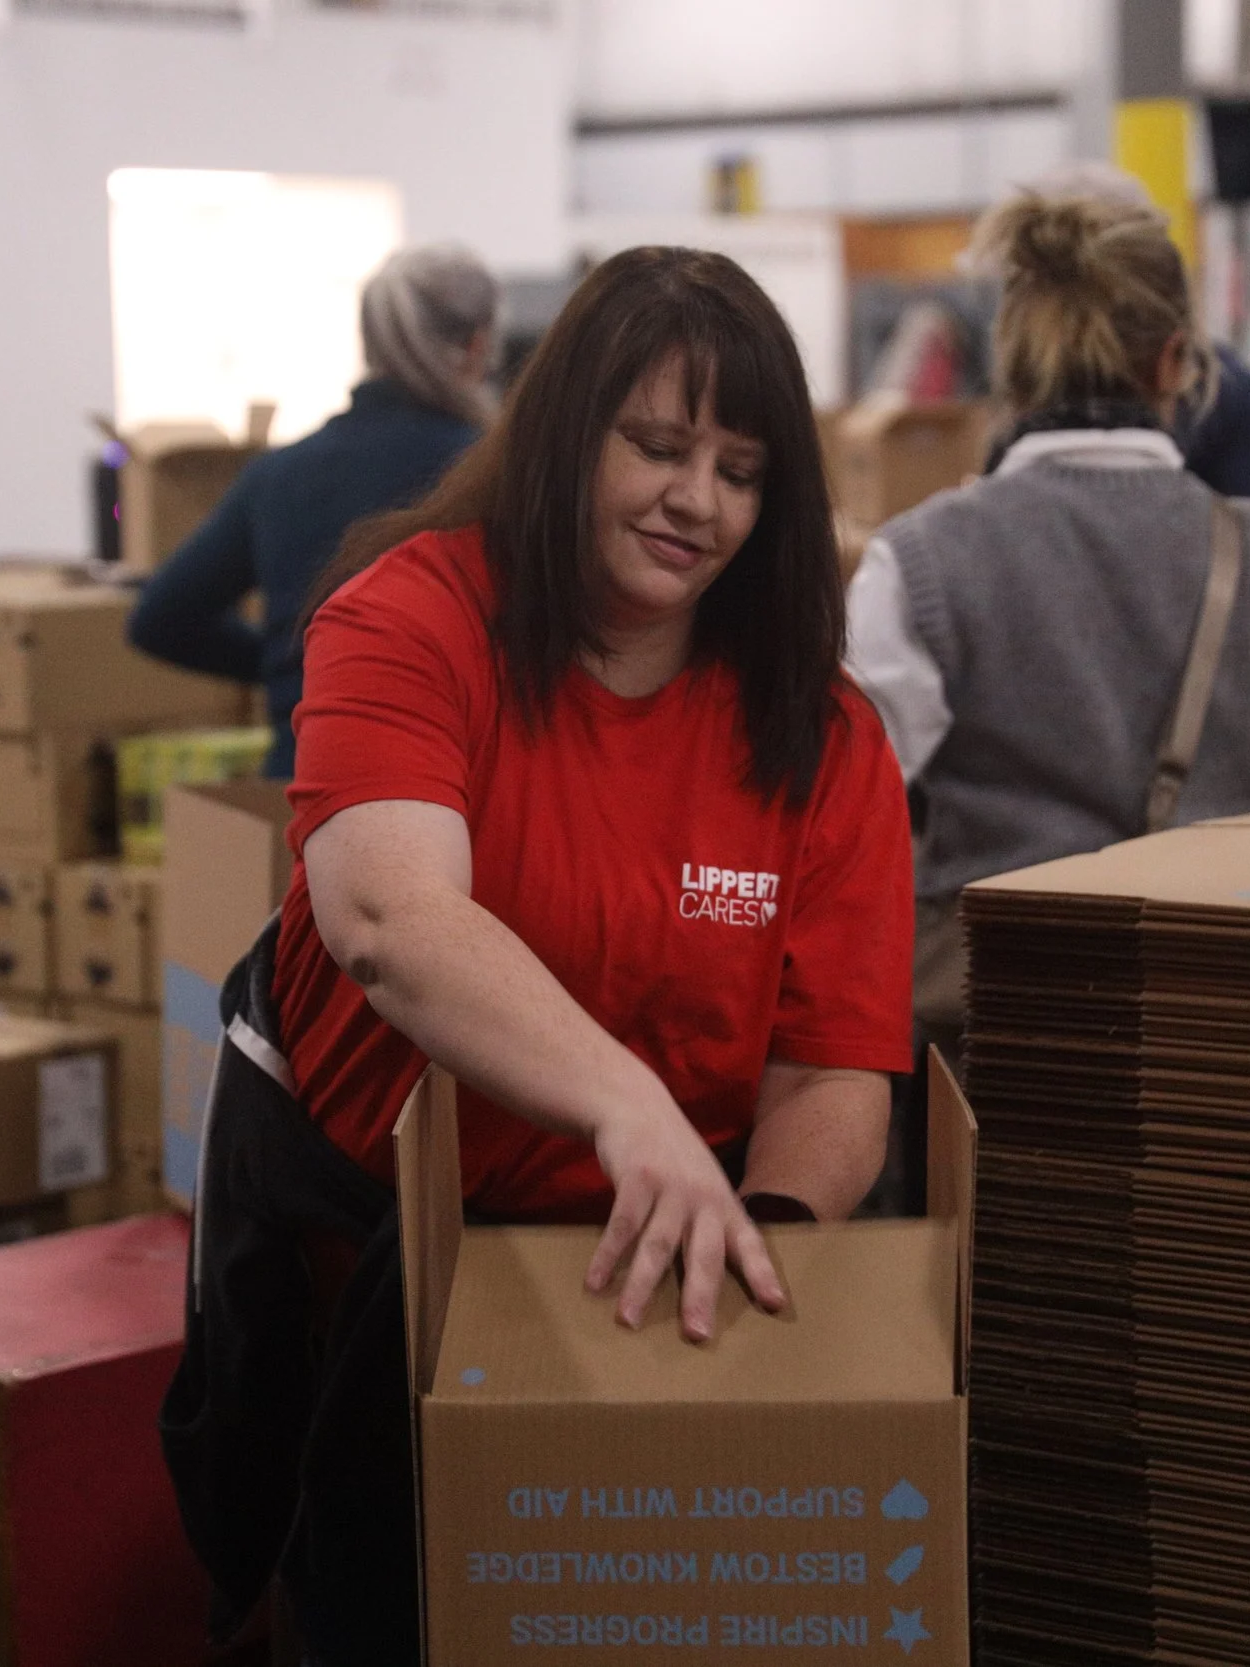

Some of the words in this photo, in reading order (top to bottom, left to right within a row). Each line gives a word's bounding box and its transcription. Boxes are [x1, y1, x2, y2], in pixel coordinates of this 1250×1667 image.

[679, 891, 759, 926] CARES
[507, 1486, 569, 1518] AID
[580, 1486, 678, 1518] WITH
[688, 1486, 865, 1518] SUPPORT
[466, 1551, 699, 1584] KNOWLEDGE
[710, 1551, 867, 1585] BESTOW
[510, 1614, 709, 1646] PROGRESS
[720, 1614, 868, 1646] INSPIRE
